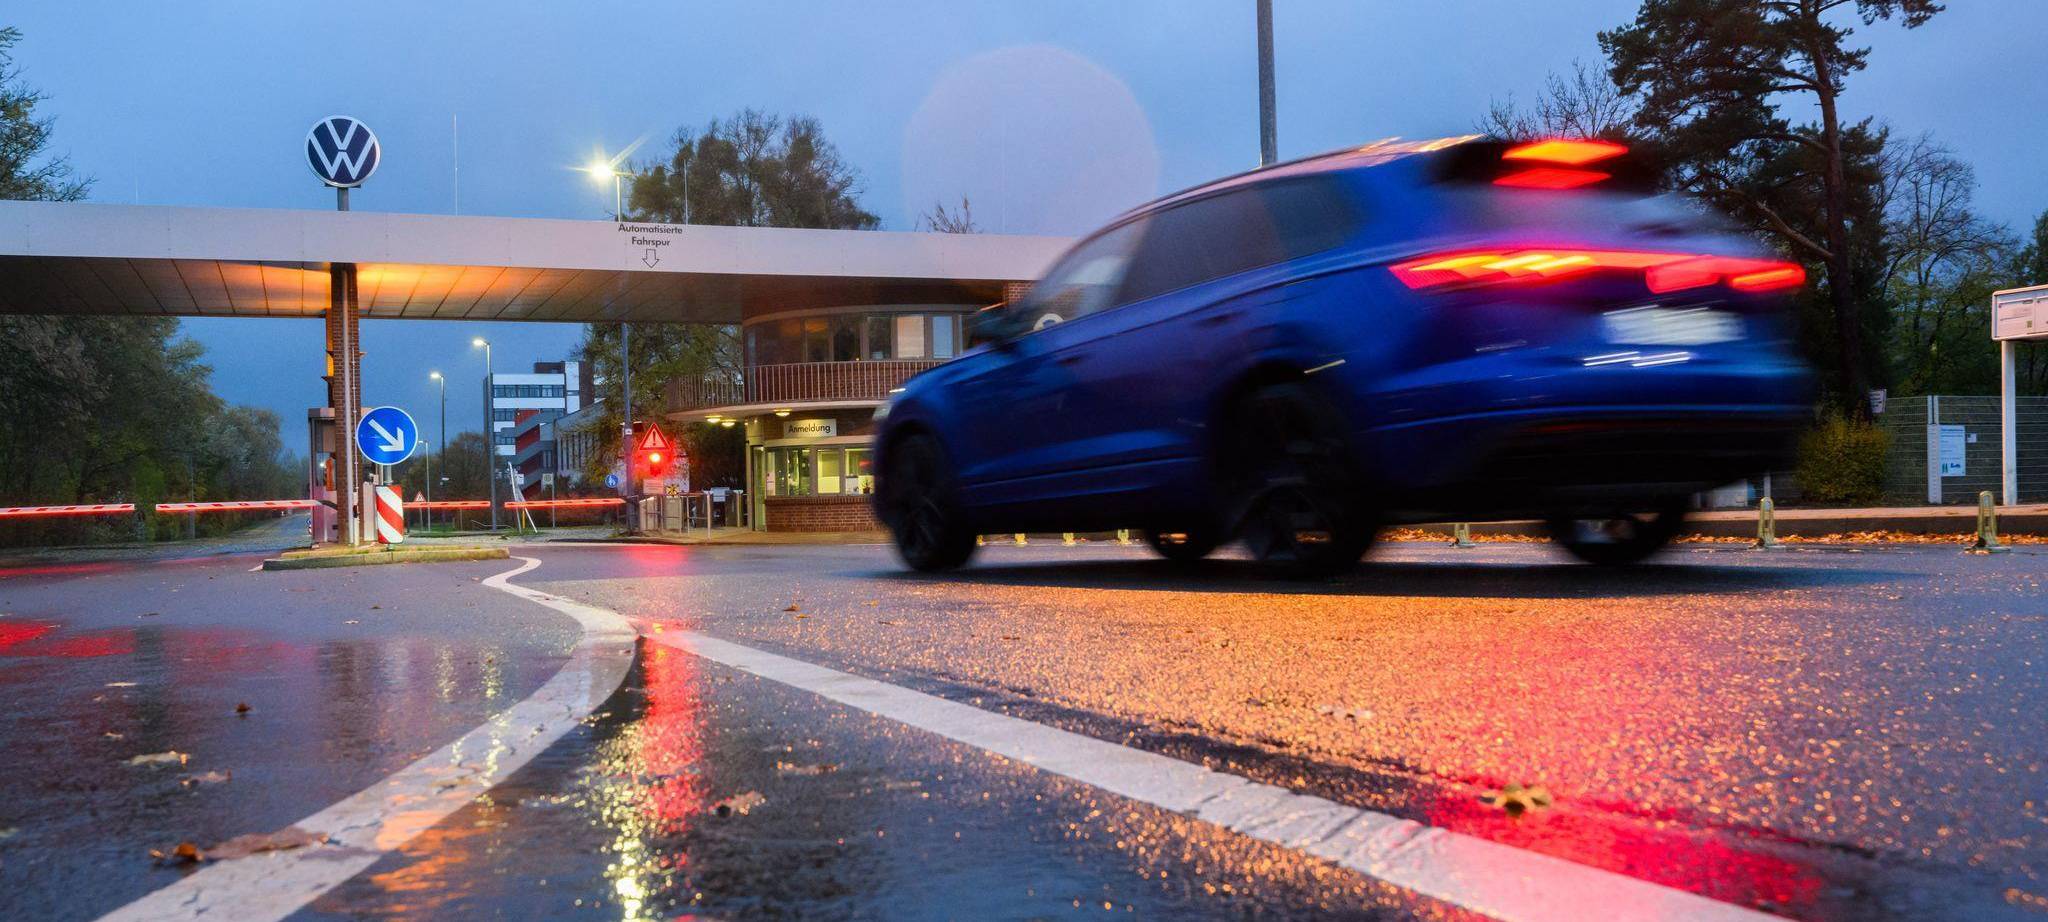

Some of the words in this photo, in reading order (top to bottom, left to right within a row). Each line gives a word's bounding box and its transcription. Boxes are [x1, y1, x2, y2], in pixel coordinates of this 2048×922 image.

[305, 116, 378, 182] VW
[618, 223, 683, 234] Automatisierte
[631, 236, 670, 247] Fahrspur
[788, 423, 831, 434] Anmeldung
